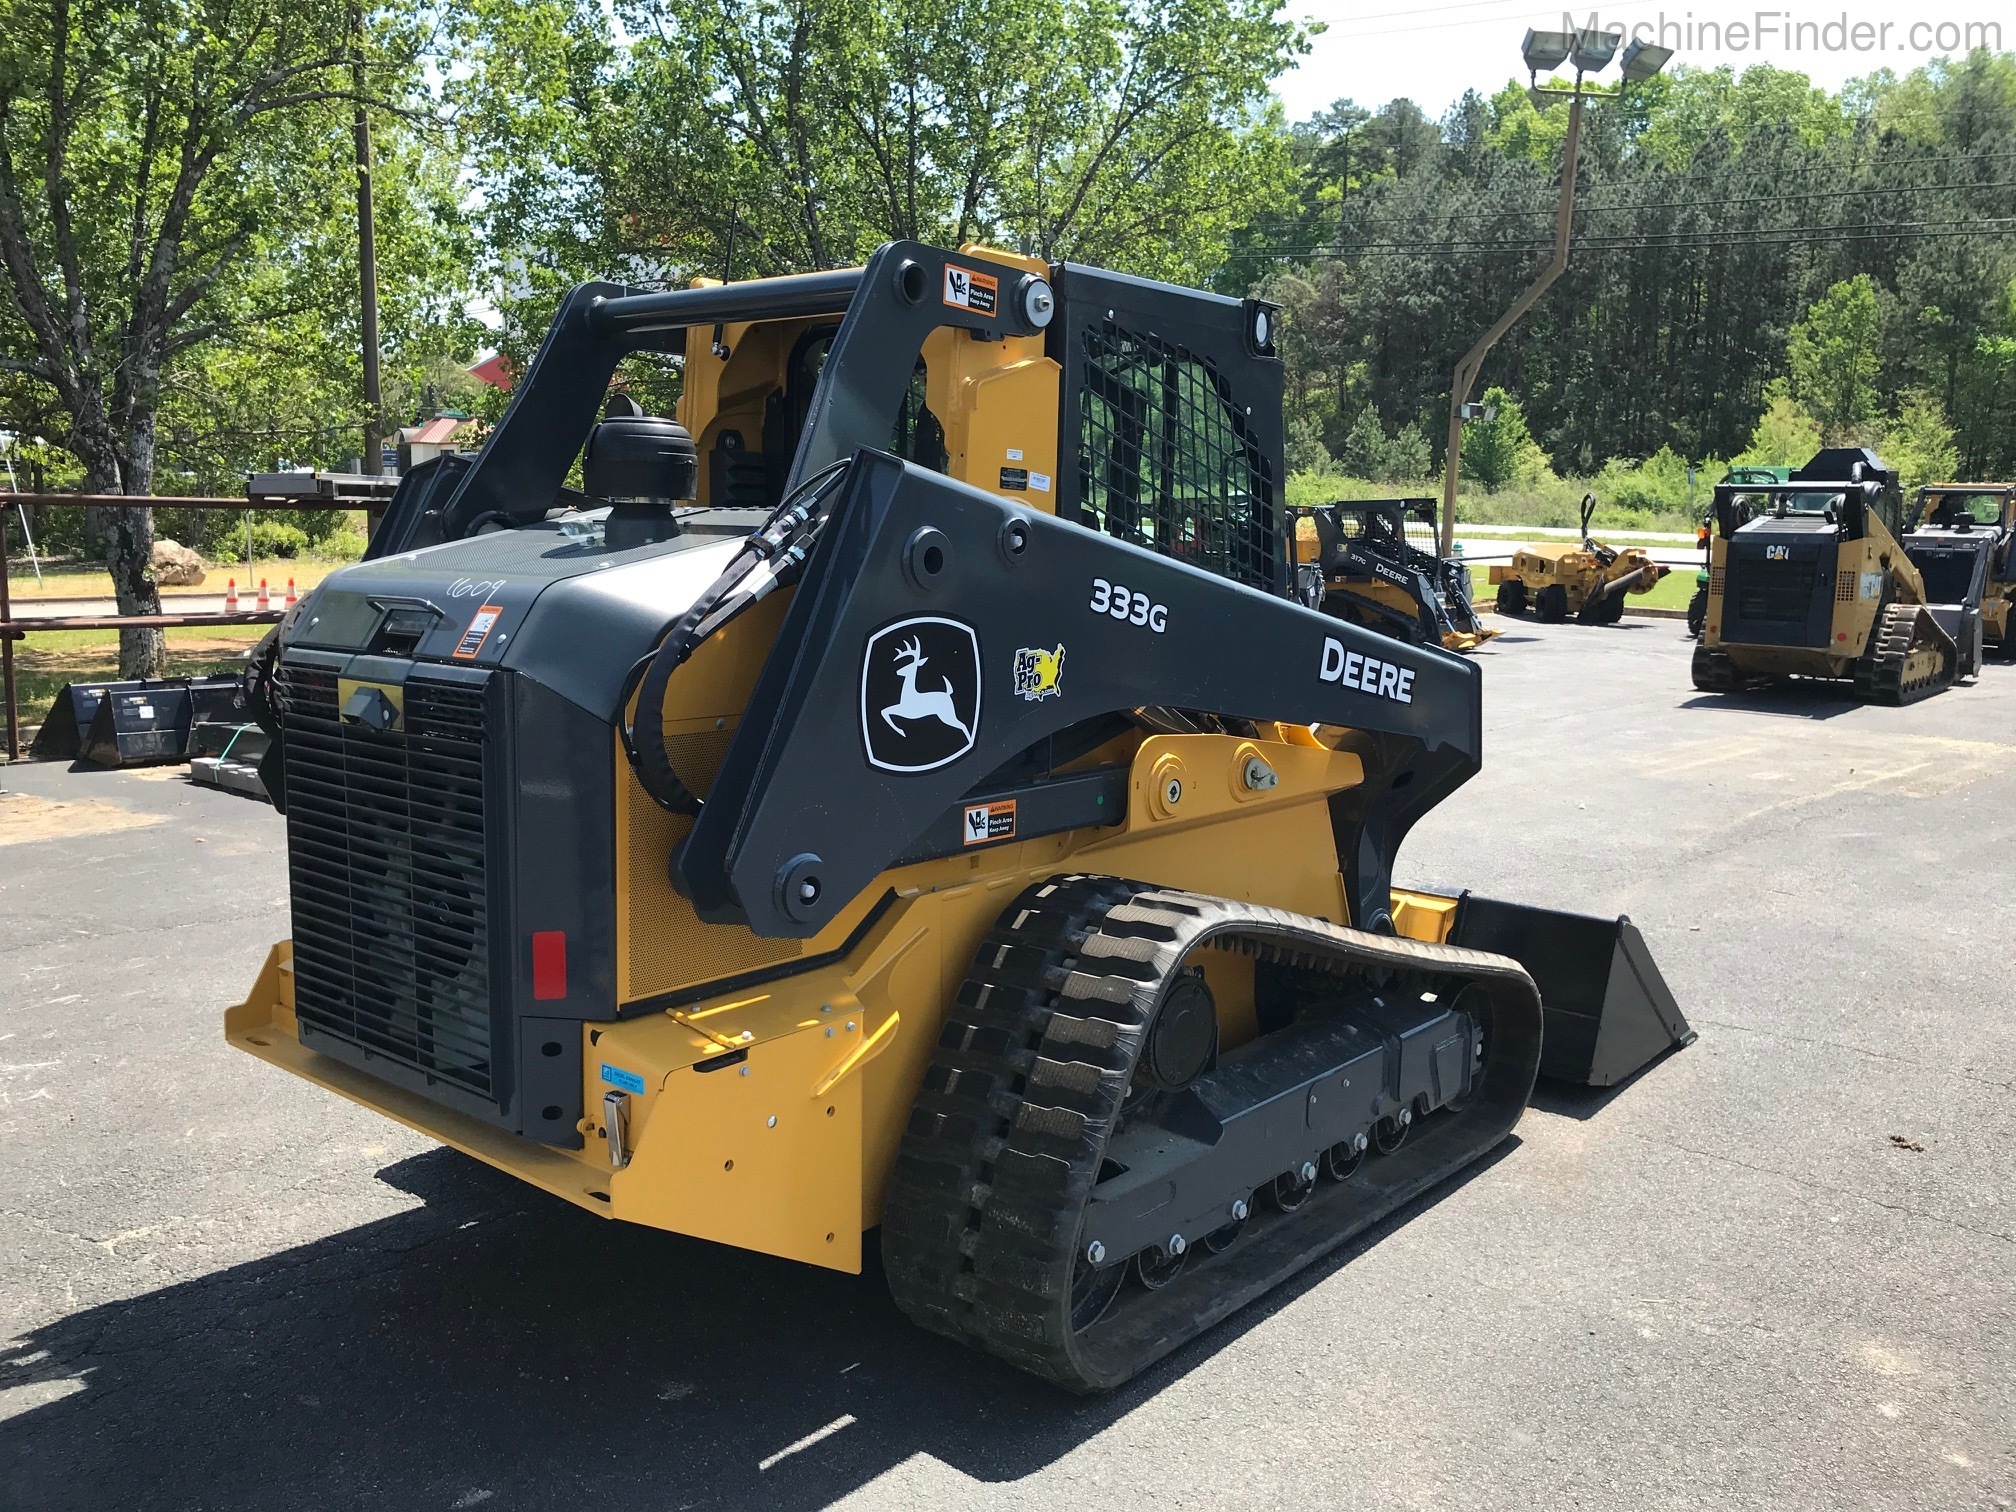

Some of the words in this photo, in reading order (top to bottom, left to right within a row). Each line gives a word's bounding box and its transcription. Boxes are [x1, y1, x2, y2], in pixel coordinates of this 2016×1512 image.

[1350, 553, 1367, 565] 317G
[1375, 562, 1409, 585] DEERE
[446, 577, 507, 606] 1609
[1090, 578, 1168, 633] 333G
[1017, 652, 1041, 674] Ag-
[1319, 636, 1416, 704] DEERE
[1017, 672, 1041, 691] Pro
